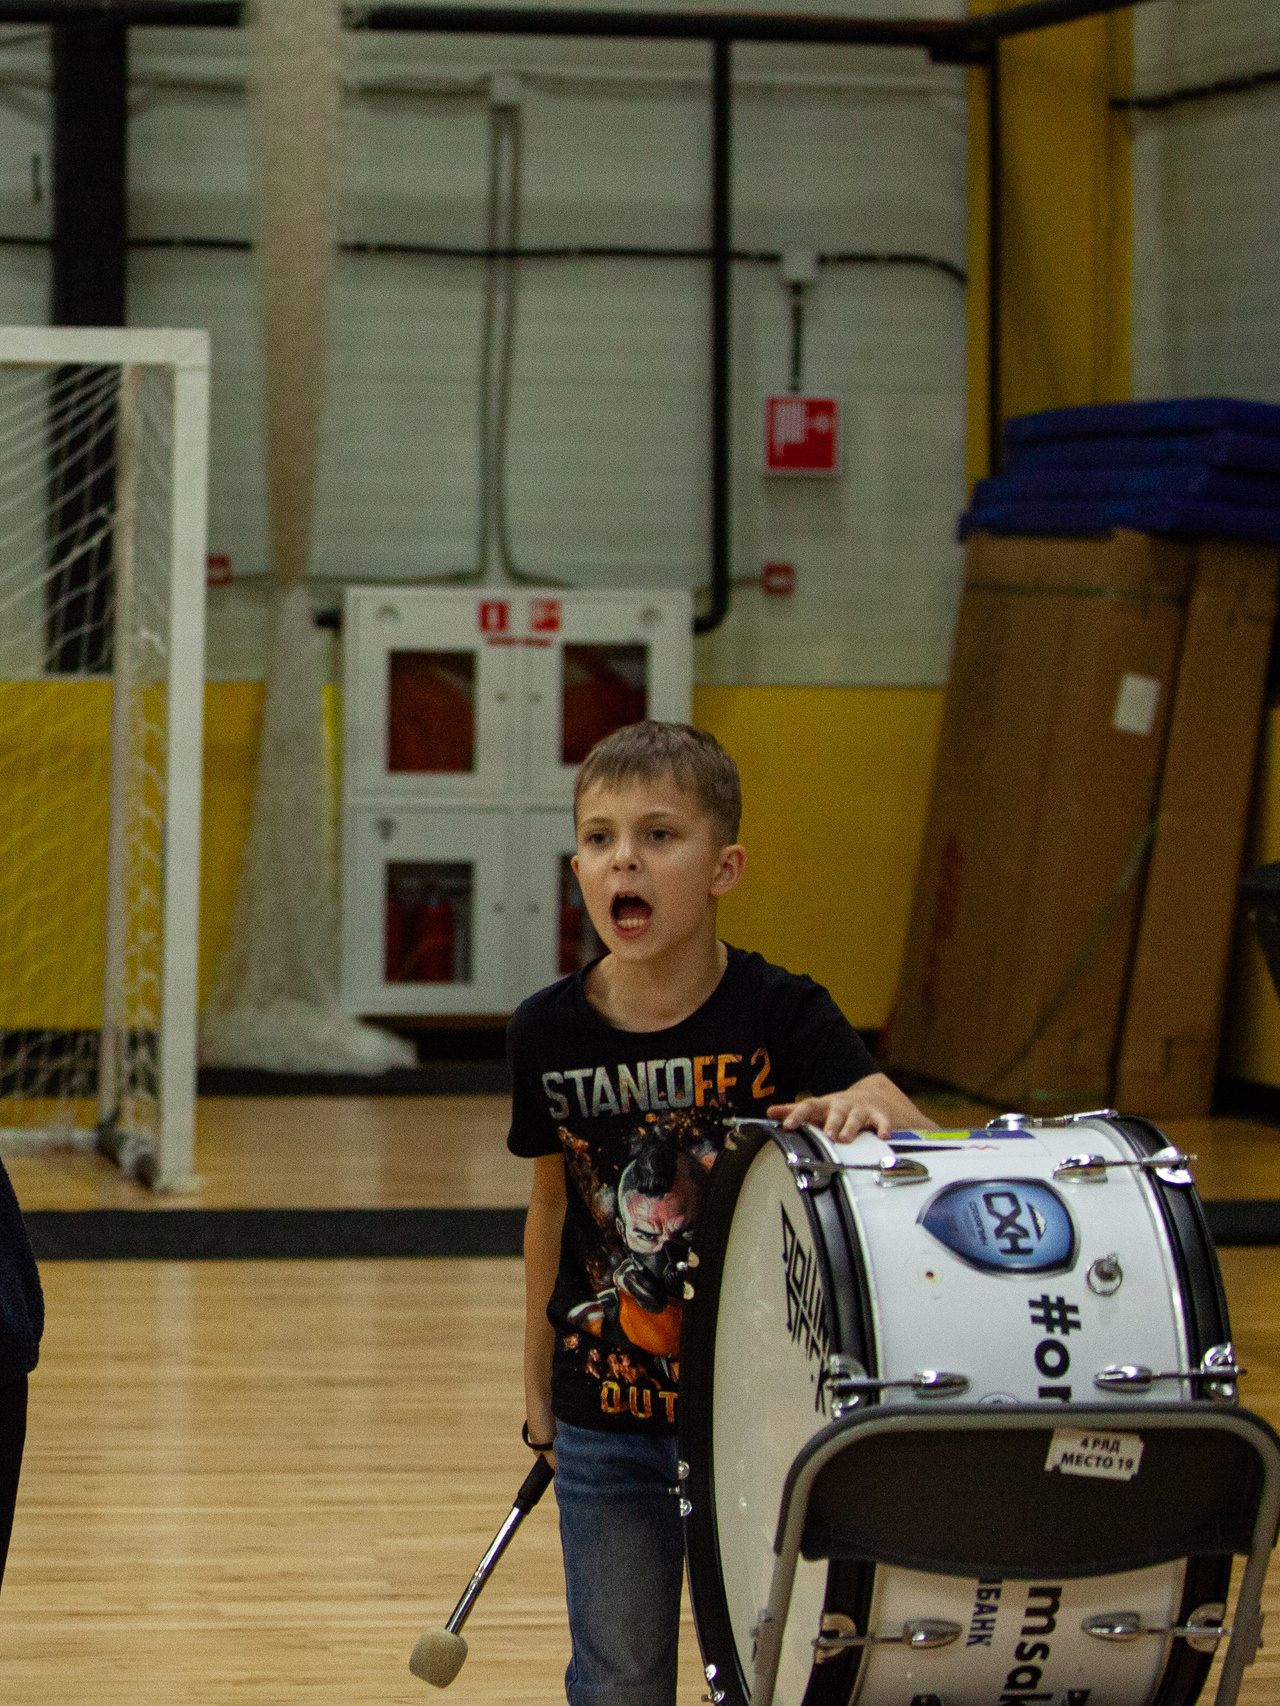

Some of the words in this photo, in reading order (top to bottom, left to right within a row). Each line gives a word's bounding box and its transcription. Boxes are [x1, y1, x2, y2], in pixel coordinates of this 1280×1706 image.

[750, 1047, 776, 1100] 2
[1061, 1452, 1114, 1470] МЕСТО
[1080, 1437, 1089, 1450] 4
[1091, 1437, 1121, 1454] РЯД
[965, 1578, 1003, 1648] БАНК
